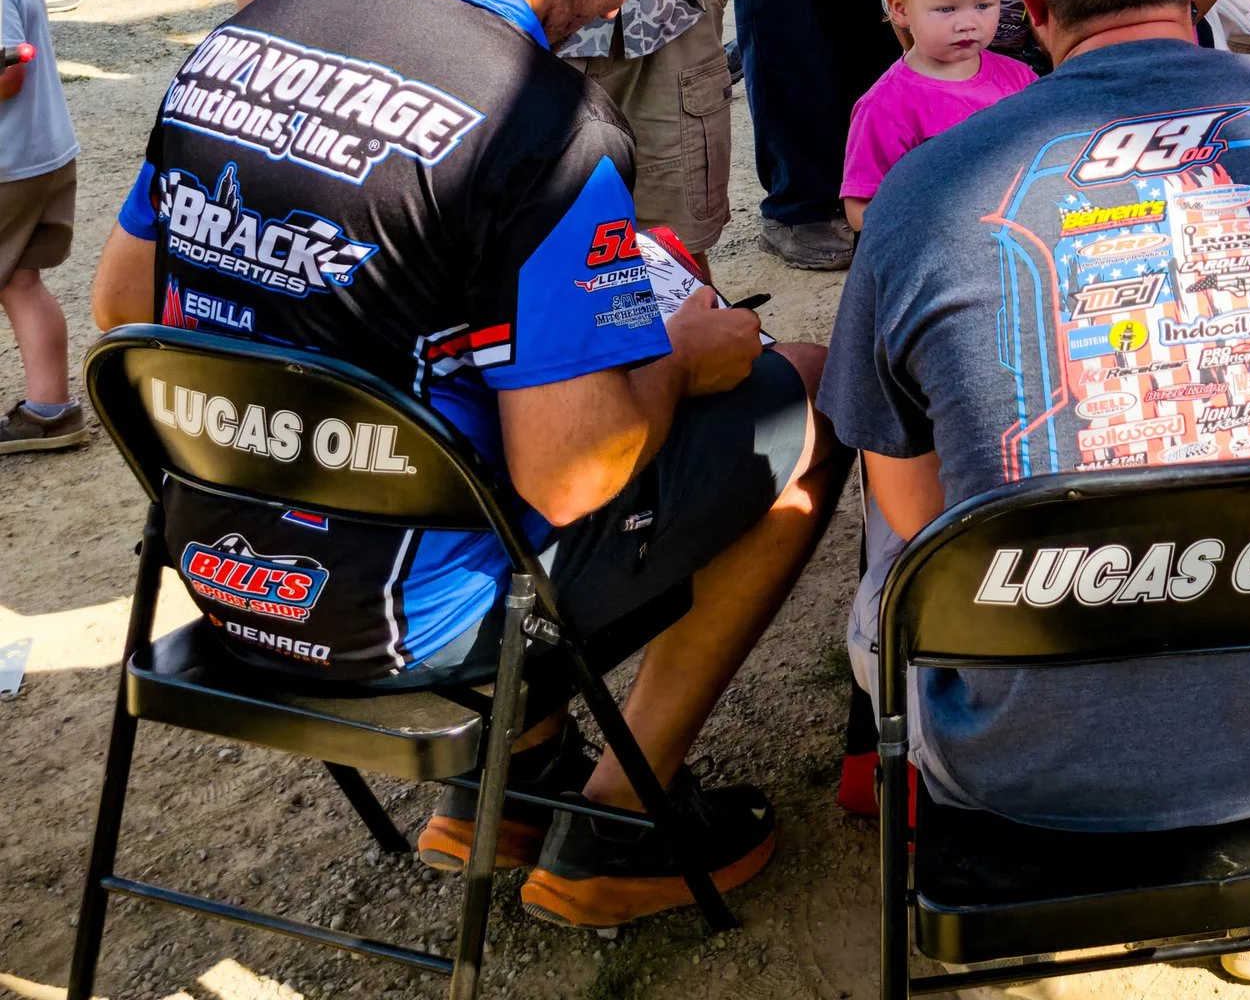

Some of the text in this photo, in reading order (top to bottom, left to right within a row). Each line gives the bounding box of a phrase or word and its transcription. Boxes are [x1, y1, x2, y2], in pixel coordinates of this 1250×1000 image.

[253, 46, 465, 153] VOLTAGE
[1077, 111, 1229, 182] 93
[1062, 200, 1167, 231] Behrent's
[169, 184, 333, 289] BRACK
[169, 235, 307, 293] PROPERTIES
[334, 272, 350, 283] 19
[184, 292, 254, 332] ESILLA
[1164, 317, 1249, 342] Indocil
[1069, 336, 1110, 350] BILSTEIN
[1202, 347, 1232, 358] PRO
[1105, 360, 1189, 381] RaceGear
[1085, 396, 1130, 413] BELL
[1201, 405, 1239, 424] JOHN
[150, 378, 411, 474] LUCAS OIL
[1083, 453, 1145, 470] ALLSTAR
[188, 550, 313, 601] BILL'S
[973, 538, 1226, 608] LUCAS
[192, 580, 308, 620] SPORT SHOP
[226, 621, 331, 660] DENAGO
